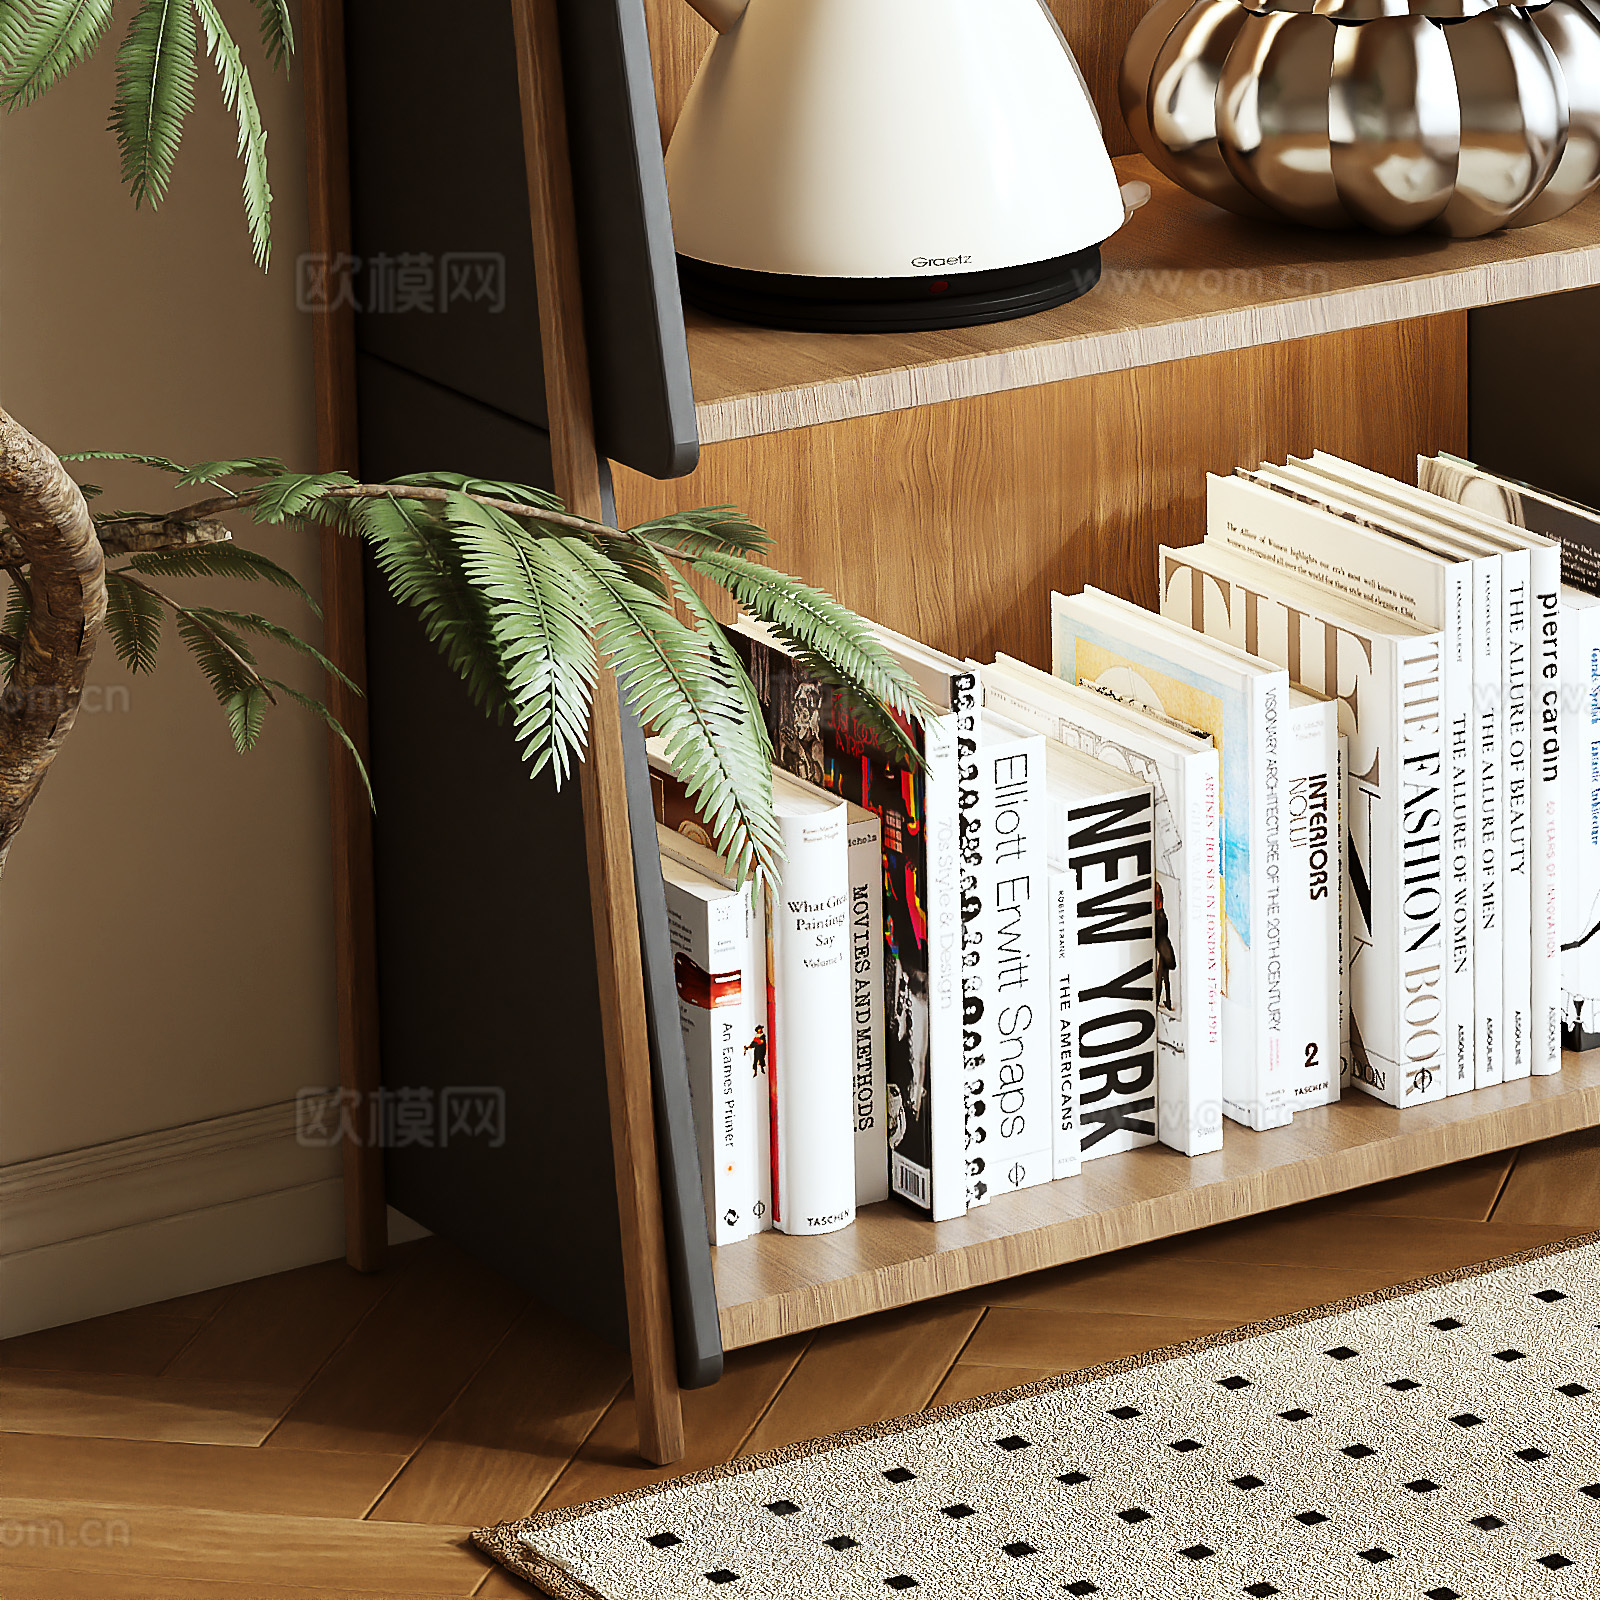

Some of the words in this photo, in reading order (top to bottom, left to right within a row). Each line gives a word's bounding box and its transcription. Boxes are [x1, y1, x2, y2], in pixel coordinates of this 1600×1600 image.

[910, 252, 973, 268] Graetz
[1509, 580, 1525, 634] THE
[1536, 592, 1559, 679] pierre
[1403, 640, 1439, 743] THE
[1509, 640, 1525, 736] ALLURE
[1265, 687, 1278, 755] VISIONARY
[1452, 712, 1467, 761] THE
[1481, 706, 1495, 755] THE
[1541, 690, 1560, 782] cardin
[1509, 740, 1525, 772] OF
[994, 753, 1028, 864] Elliott
[1265, 758, 1279, 863] ARCHITECTURE
[1452, 766, 1467, 850] ALLURE
[1482, 760, 1495, 844] ALLURE
[1509, 779, 1525, 875] BEAUTY
[1308, 773, 1328, 901] INTERIORS
[1403, 749, 1441, 953] FASHION
[1453, 854, 1467, 880] OF
[1482, 848, 1496, 876] OF
[1067, 792, 1153, 946] NEW
[1266, 865, 1280, 885] OF
[787, 900, 823, 914] What
[796, 911, 846, 932] Painting
[853, 883, 870, 974] MOVIES
[1266, 886, 1281, 916] THE
[1453, 887, 1468, 974] WOMEN
[1482, 880, 1496, 931] MEN
[803, 956, 838, 969] Volume
[815, 934, 836, 948] Say
[996, 875, 1030, 993] Erwitt
[1206, 913, 1217, 971] LONDON
[854, 978, 872, 1025] AND
[938, 932, 955, 1010] Design
[1059, 973, 1071, 1011] THE
[1267, 961, 1282, 1032] CENTURY
[722, 1022, 733, 1042] An
[1077, 958, 1156, 1153] YORK
[1304, 1042, 1319, 1068] 2
[1403, 964, 1442, 1096] BOOK
[722, 1046, 734, 1096] Eames
[855, 1027, 875, 1133] METHODS
[991, 1004, 1033, 1139] Snaps
[1060, 1019, 1073, 1132] AMERICANS
[1294, 1080, 1329, 1097] TASCHEN
[724, 1099, 736, 1148] Primer
[806, 1209, 850, 1227] TASCHEN
